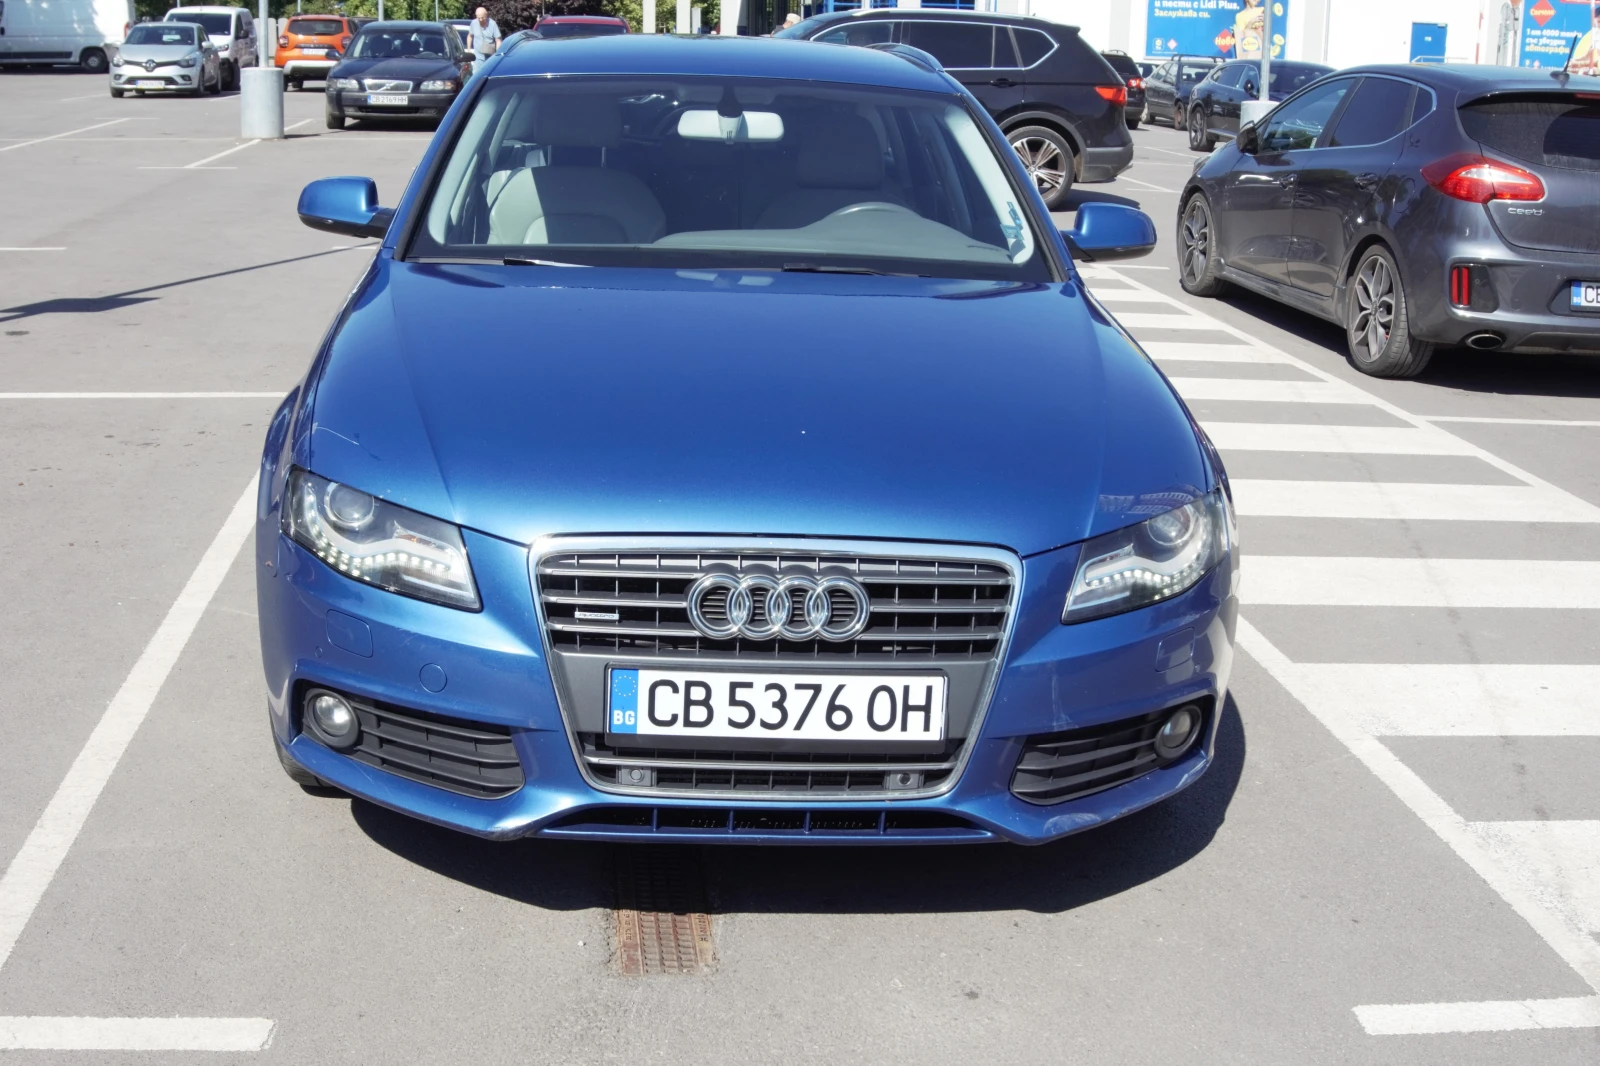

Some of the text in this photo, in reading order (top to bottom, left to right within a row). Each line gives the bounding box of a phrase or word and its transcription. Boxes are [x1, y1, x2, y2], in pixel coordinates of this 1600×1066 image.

[1162, 0, 1191, 8] пести
[1200, 0, 1217, 9] Lidl
[1218, 0, 1240, 10] Plus.
[1154, 9, 1198, 18] Заслужава
[1214, 36, 1236, 46] Ново
[647, 679, 933, 732] CB 5376 OH
[613, 709, 635, 726] BG
